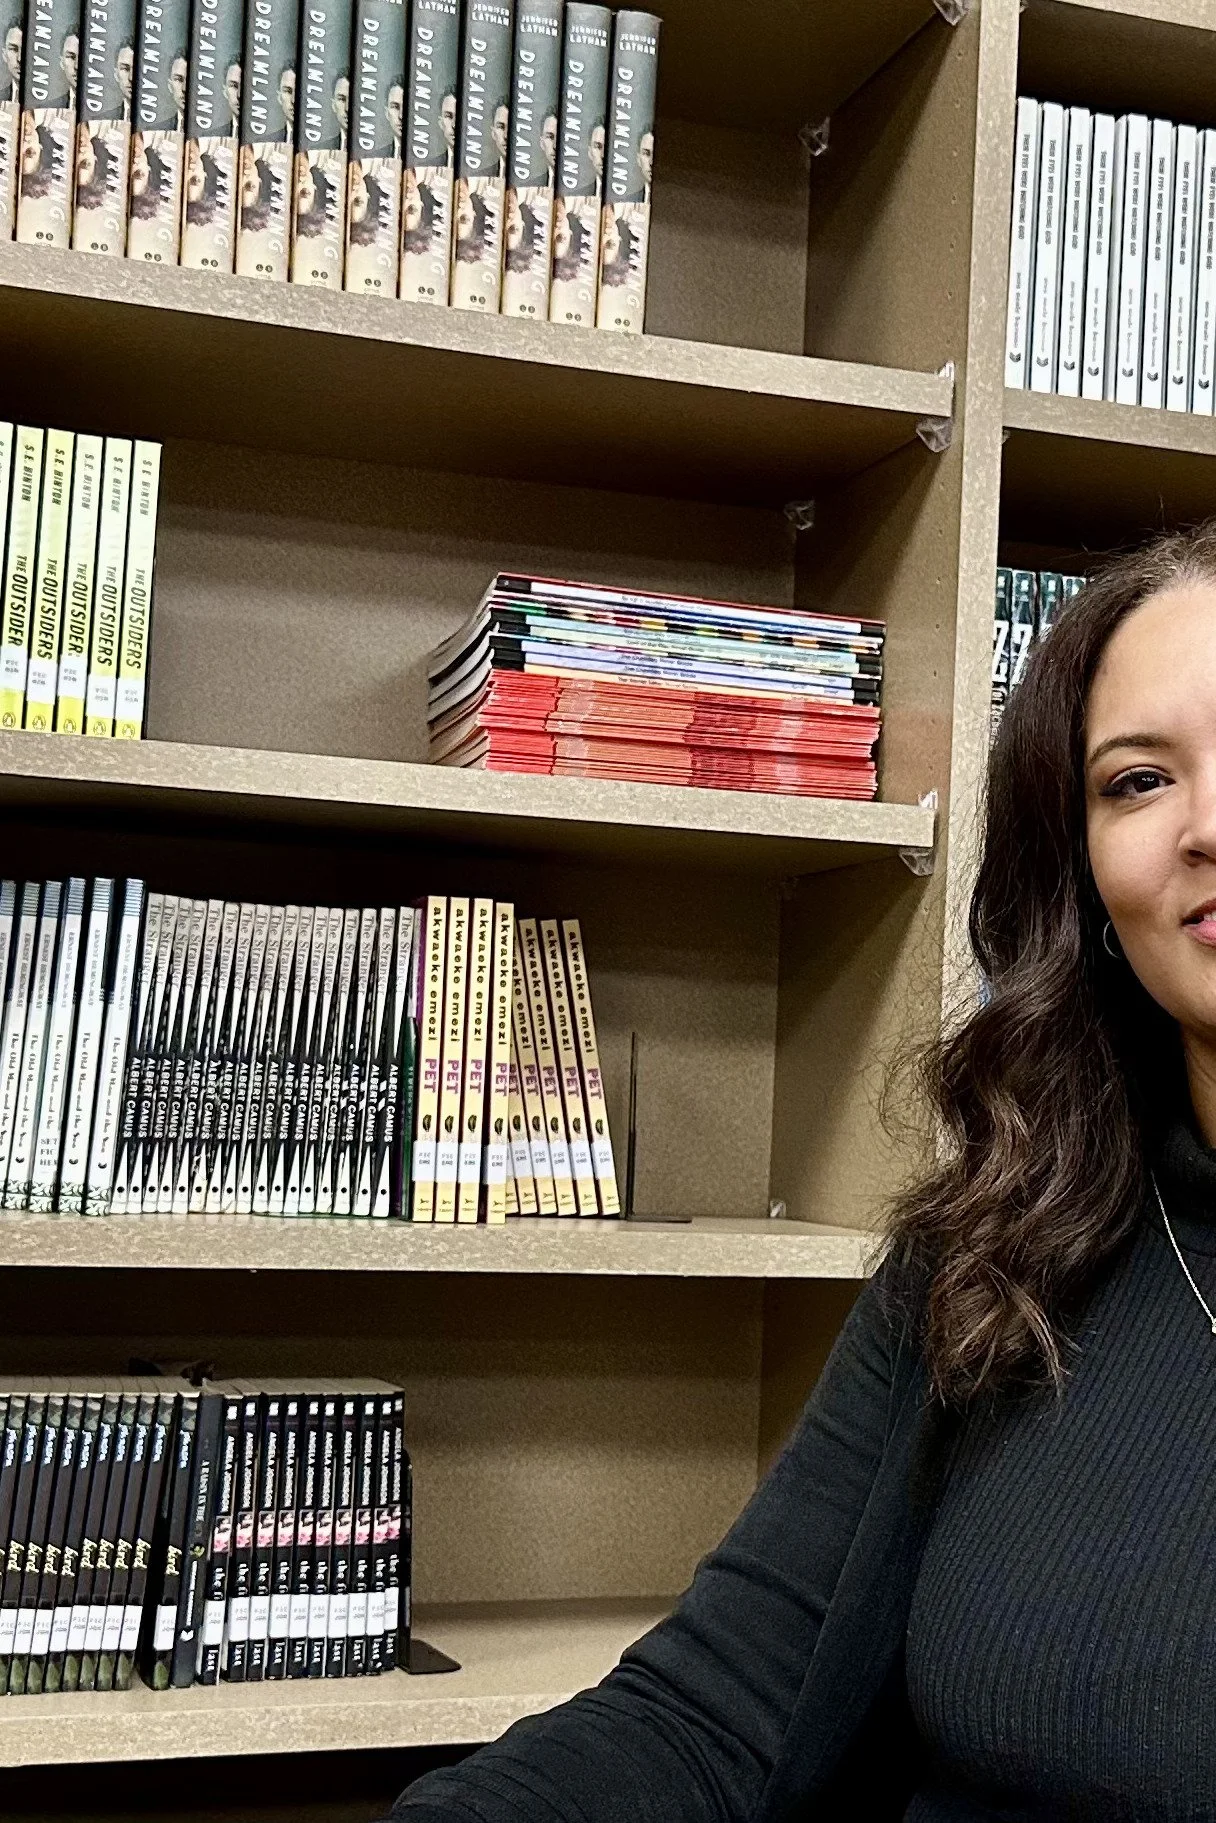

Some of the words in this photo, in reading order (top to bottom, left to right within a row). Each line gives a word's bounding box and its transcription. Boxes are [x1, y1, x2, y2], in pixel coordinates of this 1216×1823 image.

[418, 2, 456, 15] LATHAM
[471, 12, 509, 26] LATHAM
[520, 22, 558, 37] LATHAM
[570, 33, 607, 48] LATHAM
[619, 41, 656, 55] LATHAM
[32, 0, 53, 101] EAMLAND
[140, 0, 163, 123] REAMLAND
[250, 2, 272, 135] DREAMLAND
[305, 9, 327, 142] DREAMLAND
[358, 18, 380, 150] DREAMLAND
[412, 27, 434, 159] DREAMLAND
[465, 38, 487, 170] DREAMLAND
[514, 50, 535, 180] DREAMLAND
[563, 60, 585, 189] DREAMLAND
[611, 67, 634, 196] DREAMLAND
[16, 555, 27, 573] THE
[47, 558, 58, 577] THE
[76, 563, 87, 580] THE
[106, 566, 116, 583] THE
[135, 569, 145, 585] THE
[8, 574, 28, 646] OUTSIDER
[37, 577, 58, 660] OUTSIDERS
[68, 581, 88, 657] OUTSIDER
[97, 584, 118, 667] OUTSIDERS
[126, 587, 146, 669] OUTSIDERS
[150, 903, 161, 927] The
[178, 906, 190, 930] The
[209, 906, 221, 930] The
[240, 910, 253, 933] The
[384, 915, 395, 938] The
[401, 915, 413, 938] The
[142, 931, 158, 984] Stranger
[171, 934, 187, 987] Stranger
[200, 934, 217, 988] Stranger
[234, 937, 250, 991] Stranger
[431, 907, 442, 983] akwaeke
[453, 908, 465, 984] akwaeke
[476, 908, 489, 984] akwaeke
[499, 913, 510, 988] akwaeke
[377, 942, 391, 994] Stranger
[396, 943, 410, 993] Stranger
[525, 928, 542, 997] akwaeke
[536, 1004, 551, 1050] emezi
[546, 929, 563, 999] akwaeke
[557, 1004, 572, 1051] emezi
[568, 931, 586, 1001] akwaeke
[580, 1007, 595, 1053] emezi
[428, 990, 437, 1041] emezi
[450, 992, 460, 1042] emezi
[474, 991, 483, 1041] emezi
[498, 996, 507, 1045] emezi
[517, 1002, 532, 1049] emezi
[128, 1057, 141, 1098] ALBERT
[158, 1059, 171, 1099] ALBERT
[187, 1059, 201, 1100] ALBERT
[220, 1061, 234, 1101] ALBERT
[283, 1062, 296, 1101] ALBERT
[313, 1063, 325, 1102] ALBERT
[369, 1064, 379, 1103] ALBERT
[387, 1064, 399, 1103] ALBERT
[424, 1059, 437, 1093] PET
[446, 1060, 459, 1094] PET
[469, 1059, 483, 1093] PET
[495, 1062, 507, 1097] PET
[524, 1064, 538, 1097] PET
[542, 1066, 557, 1098] PET
[565, 1066, 580, 1098] PET
[587, 1068, 602, 1099] PET
[123, 1101, 136, 1138] CAMUS
[154, 1102, 167, 1139] CAMUS
[185, 1102, 197, 1139] CAMUS
[217, 1102, 229, 1140] CAMUS
[279, 1103, 291, 1140] CAMUS
[309, 1103, 321, 1140] CAMUS
[365, 1105, 377, 1142] CAMUS
[384, 1104, 396, 1142] CAMUS
[237, 1563, 249, 1583] the
[300, 1560, 310, 1581] the
